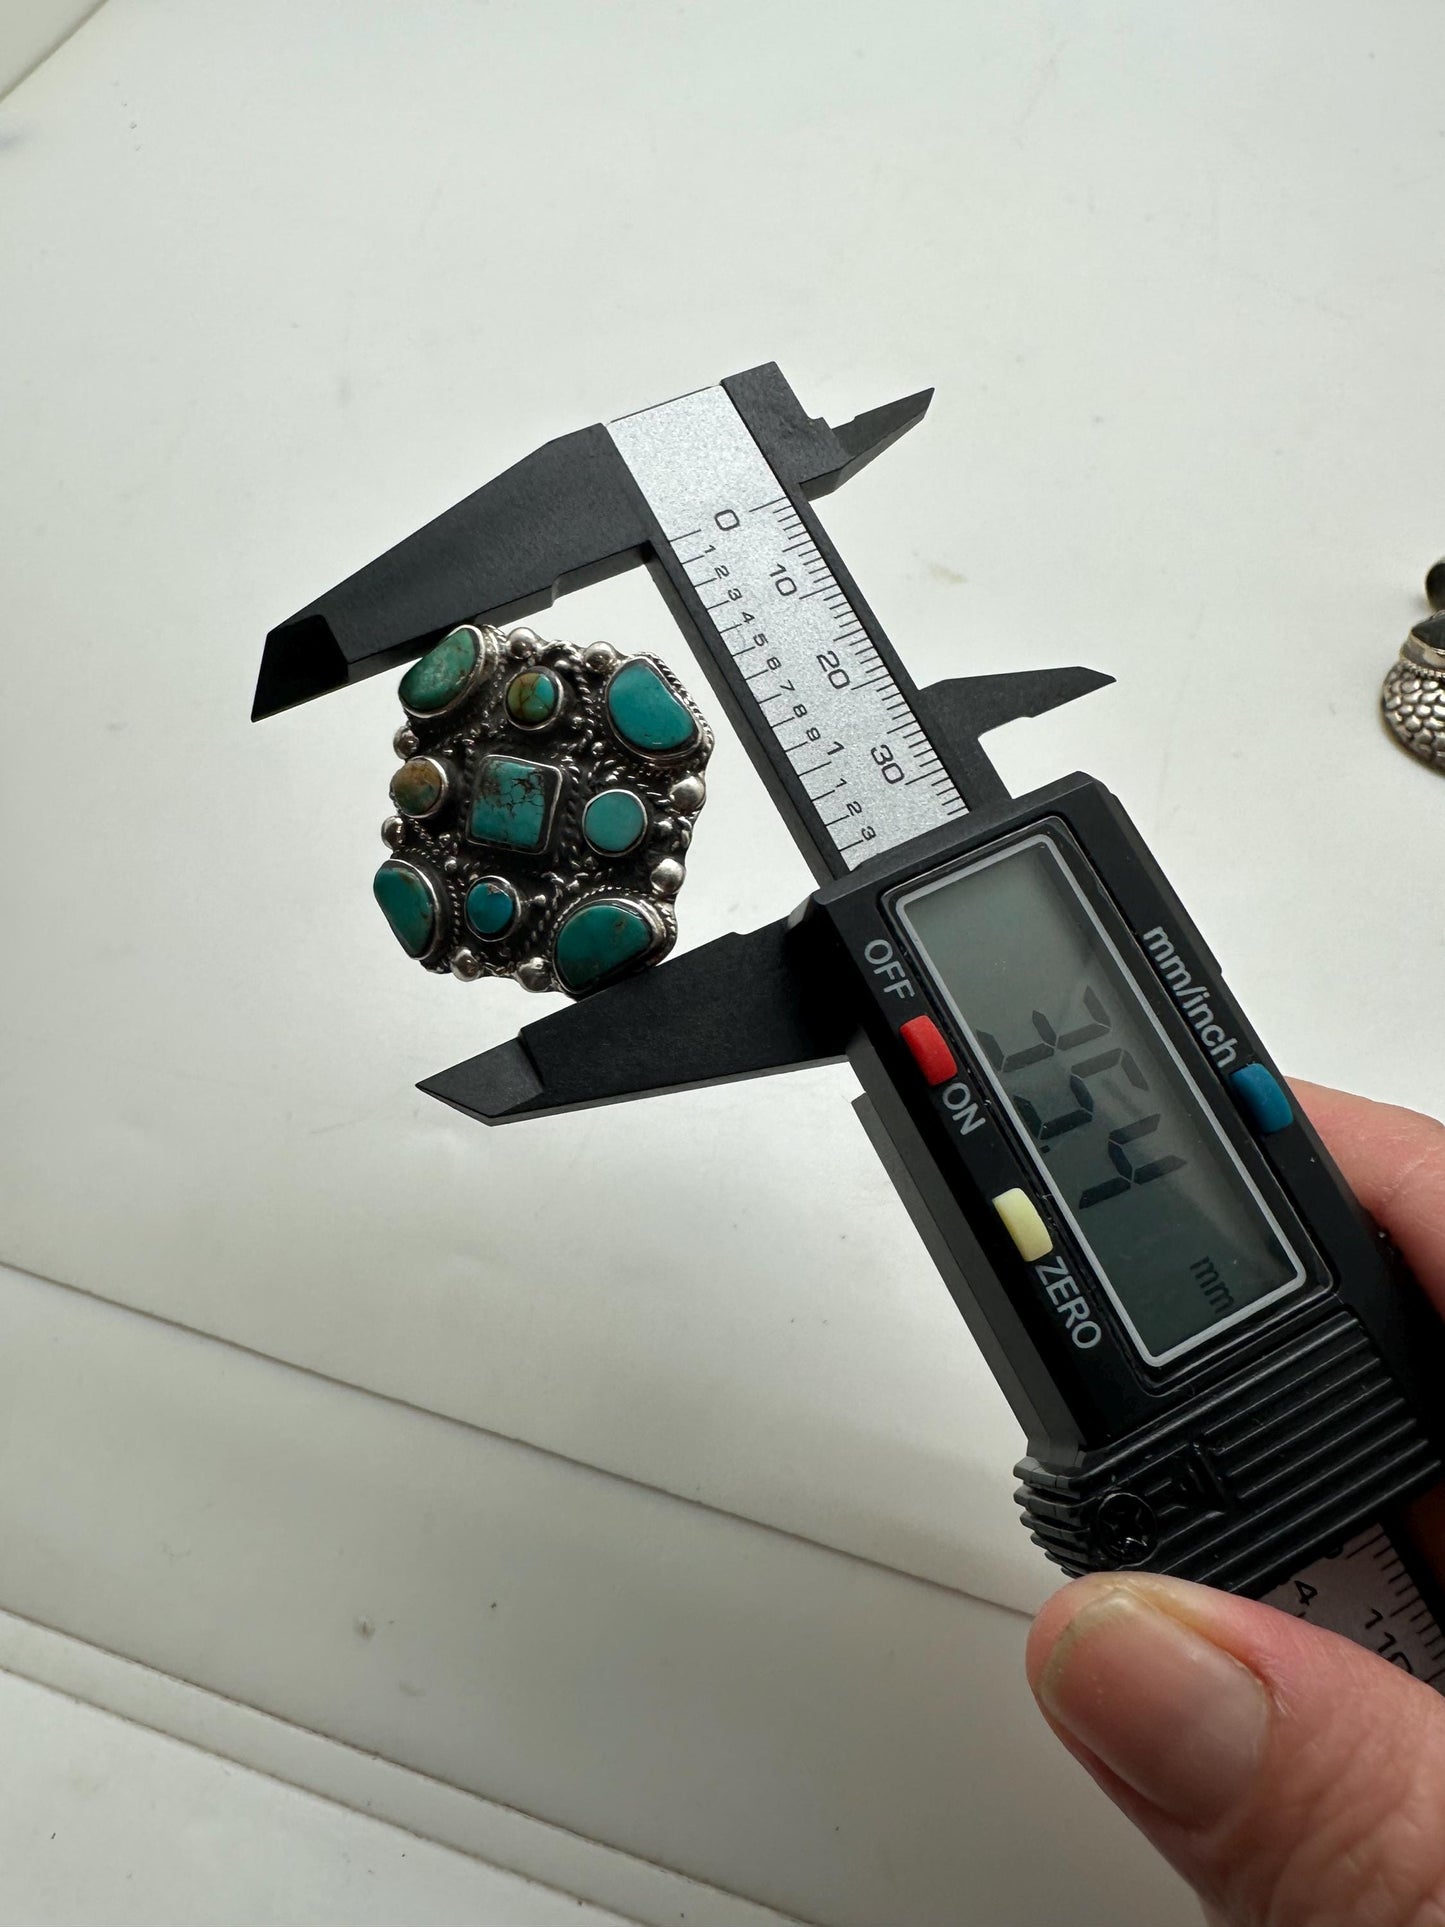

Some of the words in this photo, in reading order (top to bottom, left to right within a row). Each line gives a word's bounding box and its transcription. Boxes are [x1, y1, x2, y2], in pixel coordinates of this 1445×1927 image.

[704, 544, 717, 555] 1
[714, 565, 730, 580] 2
[727, 588, 743, 602] 3
[741, 611, 756, 624] 4
[714, 508, 741, 532] 0
[769, 562, 798, 597] 10
[816, 650, 851, 690] 20
[870, 744, 905, 785] 30
[752, 632, 769, 647] 5
[766, 656, 782, 671] 6
[779, 679, 796, 692] 7
[792, 703, 808, 718] 8
[805, 727, 821, 742] 9
[826, 741, 845, 756] 1
[835, 778, 848, 789] 1
[846, 800, 863, 816] 2
[861, 825, 877, 841] 3
[1143, 925, 1237, 1068] mm/inch
[863, 938, 915, 999] OFF
[941, 1082, 987, 1135] ON
[976, 985, 1188, 1210] 35.4
[1190, 1255, 1235, 1315] mm
[1036, 1257, 1102, 1350] ZERO
[1294, 1580, 1318, 1606] 4
